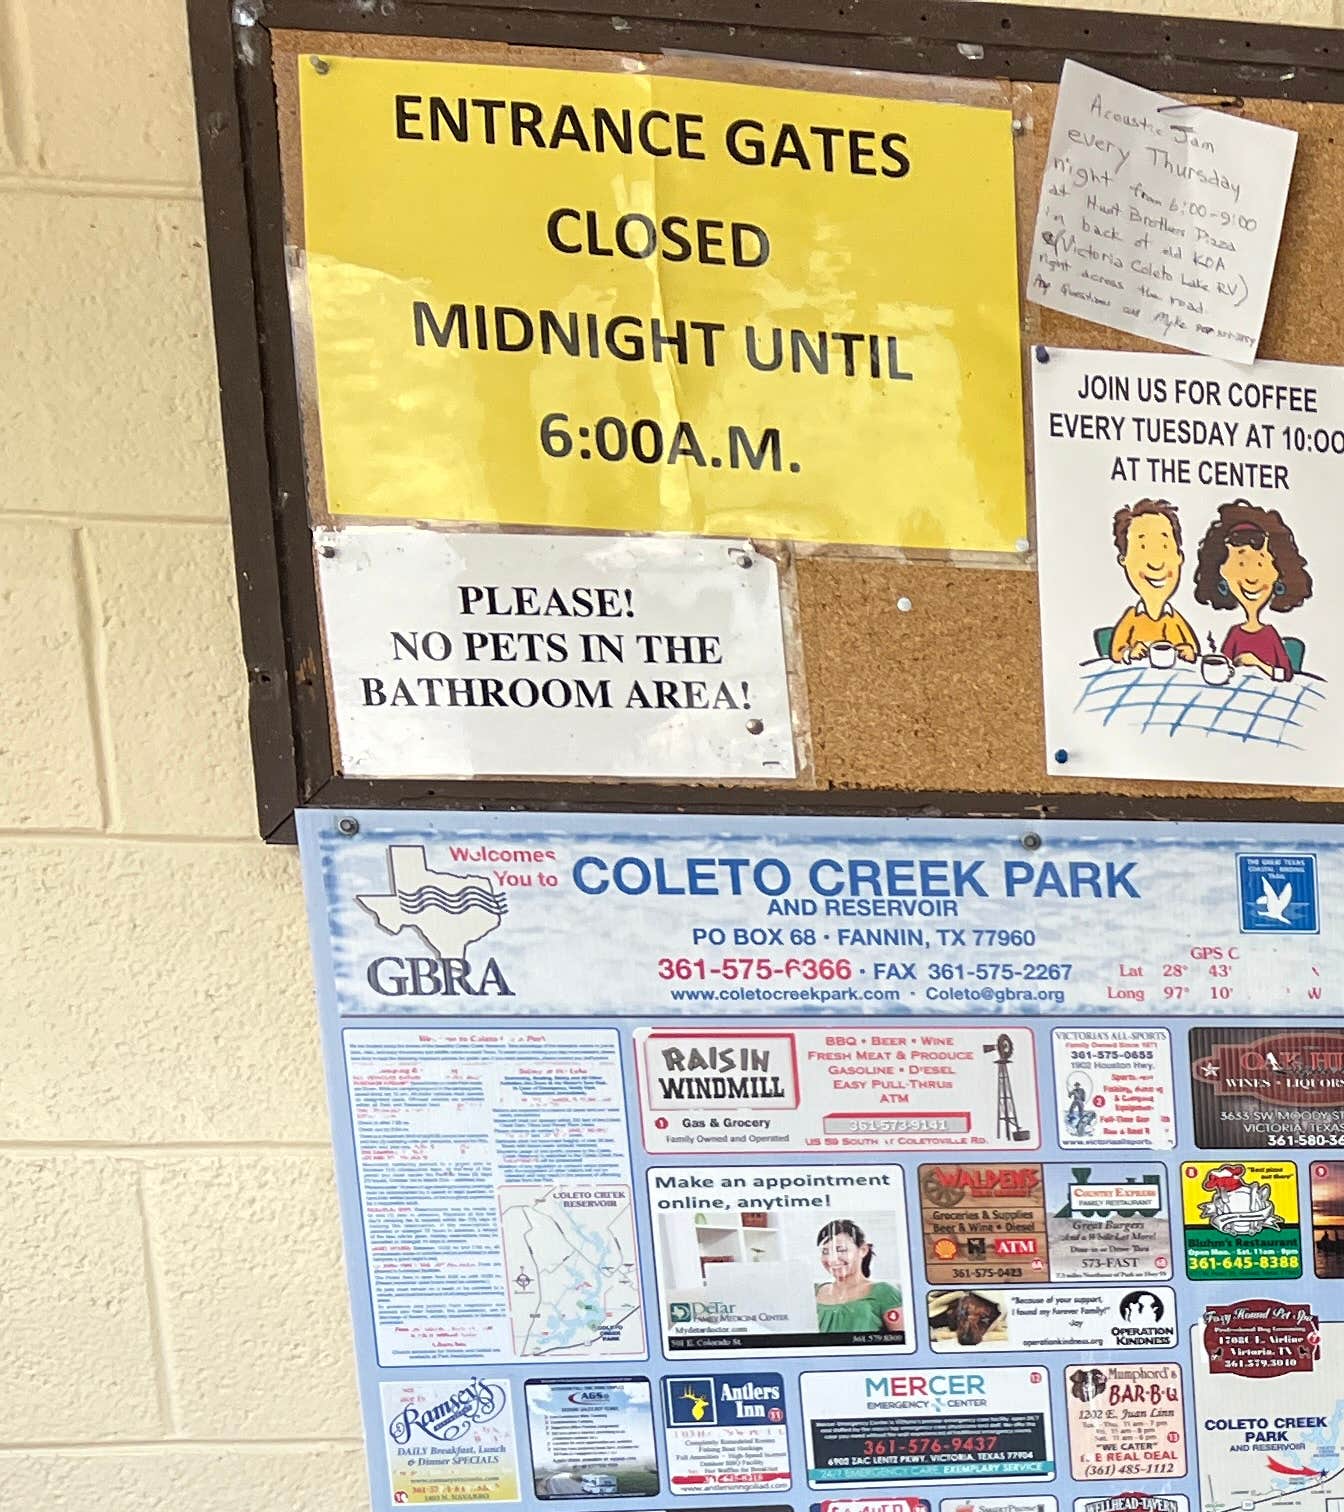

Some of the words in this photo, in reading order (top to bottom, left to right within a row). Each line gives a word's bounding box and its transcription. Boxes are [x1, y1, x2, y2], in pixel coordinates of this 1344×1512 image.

[1089, 94, 1162, 136] Acoustic
[1170, 125, 1215, 153] Jam
[394, 94, 706, 161] ENTRANCE
[725, 118, 911, 179] GATES
[1067, 128, 1130, 173] every
[1145, 146, 1240, 202] Thursday
[1053, 156, 1112, 187] night
[1130, 183, 1162, 205] from
[546, 208, 771, 269] CLOSED
[411, 300, 725, 367] MIDNIGHT
[744, 325, 914, 381] UNTIL
[1077, 374, 1129, 401] JOIN
[1137, 377, 1167, 402] US
[1174, 379, 1221, 406] FOR
[1228, 382, 1317, 413] COFFEE
[1049, 413, 1125, 440] EVERY
[1132, 417, 1238, 446] TUESDAY
[1245, 423, 1274, 449] AT
[539, 412, 802, 473] 6:00A.M.
[1110, 456, 1141, 481] AT
[1146, 458, 1190, 483] THE
[1198, 460, 1289, 489] CENTER
[458, 585, 635, 618] PLEASE!
[390, 631, 452, 661] NO
[464, 632, 568, 663] PETS
[578, 634, 624, 663] IN
[635, 635, 722, 665] THE
[361, 677, 611, 708] BATHROOM
[624, 680, 751, 710] AREA!
[448, 846, 556, 863] Welcomes
[493, 870, 531, 887] You
[537, 871, 558, 887] to
[572, 855, 791, 896] COLETO
[808, 859, 989, 898] CREEK
[1004, 860, 1141, 898] PARK
[766, 898, 817, 916] AND
[824, 899, 959, 917] RESERVOIR
[692, 928, 724, 945] PO
[733, 928, 782, 946] BOX
[789, 929, 816, 946] 68
[836, 929, 930, 948] FANNIN,
[936, 929, 966, 946] TX
[971, 929, 1036, 947] 77960
[1190, 947, 1224, 960] GPS
[366, 955, 515, 996] GBRA
[873, 962, 916, 980] FAX
[927, 964, 1073, 981] 361-575-2267
[1119, 965, 1143, 977] Lat
[670, 986, 900, 1003] www.coletocreekpark.com
[926, 986, 1065, 1003] Coleto@gbra.org
[1107, 986, 1144, 1001] Long
[825, 1036, 857, 1046] BBQ
[661, 1046, 769, 1073] RAISIN
[658, 1076, 784, 1099] WINDMILL
[1225, 1078, 1270, 1088] WINES
[879, 1093, 909, 1103] ATM
[682, 1118, 706, 1127] Gas
[709, 1118, 719, 1127] &
[723, 1117, 771, 1129] Grocery
[655, 1176, 714, 1188] Make
[721, 1177, 746, 1188] an
[752, 1174, 891, 1189] appointment
[657, 1196, 731, 1210] online,
[737, 1194, 831, 1210] anytime!
[996, 1240, 1034, 1252] ATM
[1081, 1258, 1139, 1268] 573-FAST
[1189, 1256, 1299, 1270] 361-645-8388
[1111, 1327, 1173, 1336] OPERATION
[1116, 1336, 1171, 1345] KINDNESS
[720, 1382, 780, 1401] Antlers
[865, 1374, 985, 1398] MERCER
[735, 1400, 765, 1418] Inn
[1204, 1419, 1268, 1430] COLETO
[1274, 1416, 1328, 1428] CREEK
[863, 1436, 997, 1455] 361-576-9437
[1245, 1430, 1289, 1442] PARK
[1084, 1464, 1116, 1477] (361)
[1118, 1463, 1174, 1474] 485-1112
